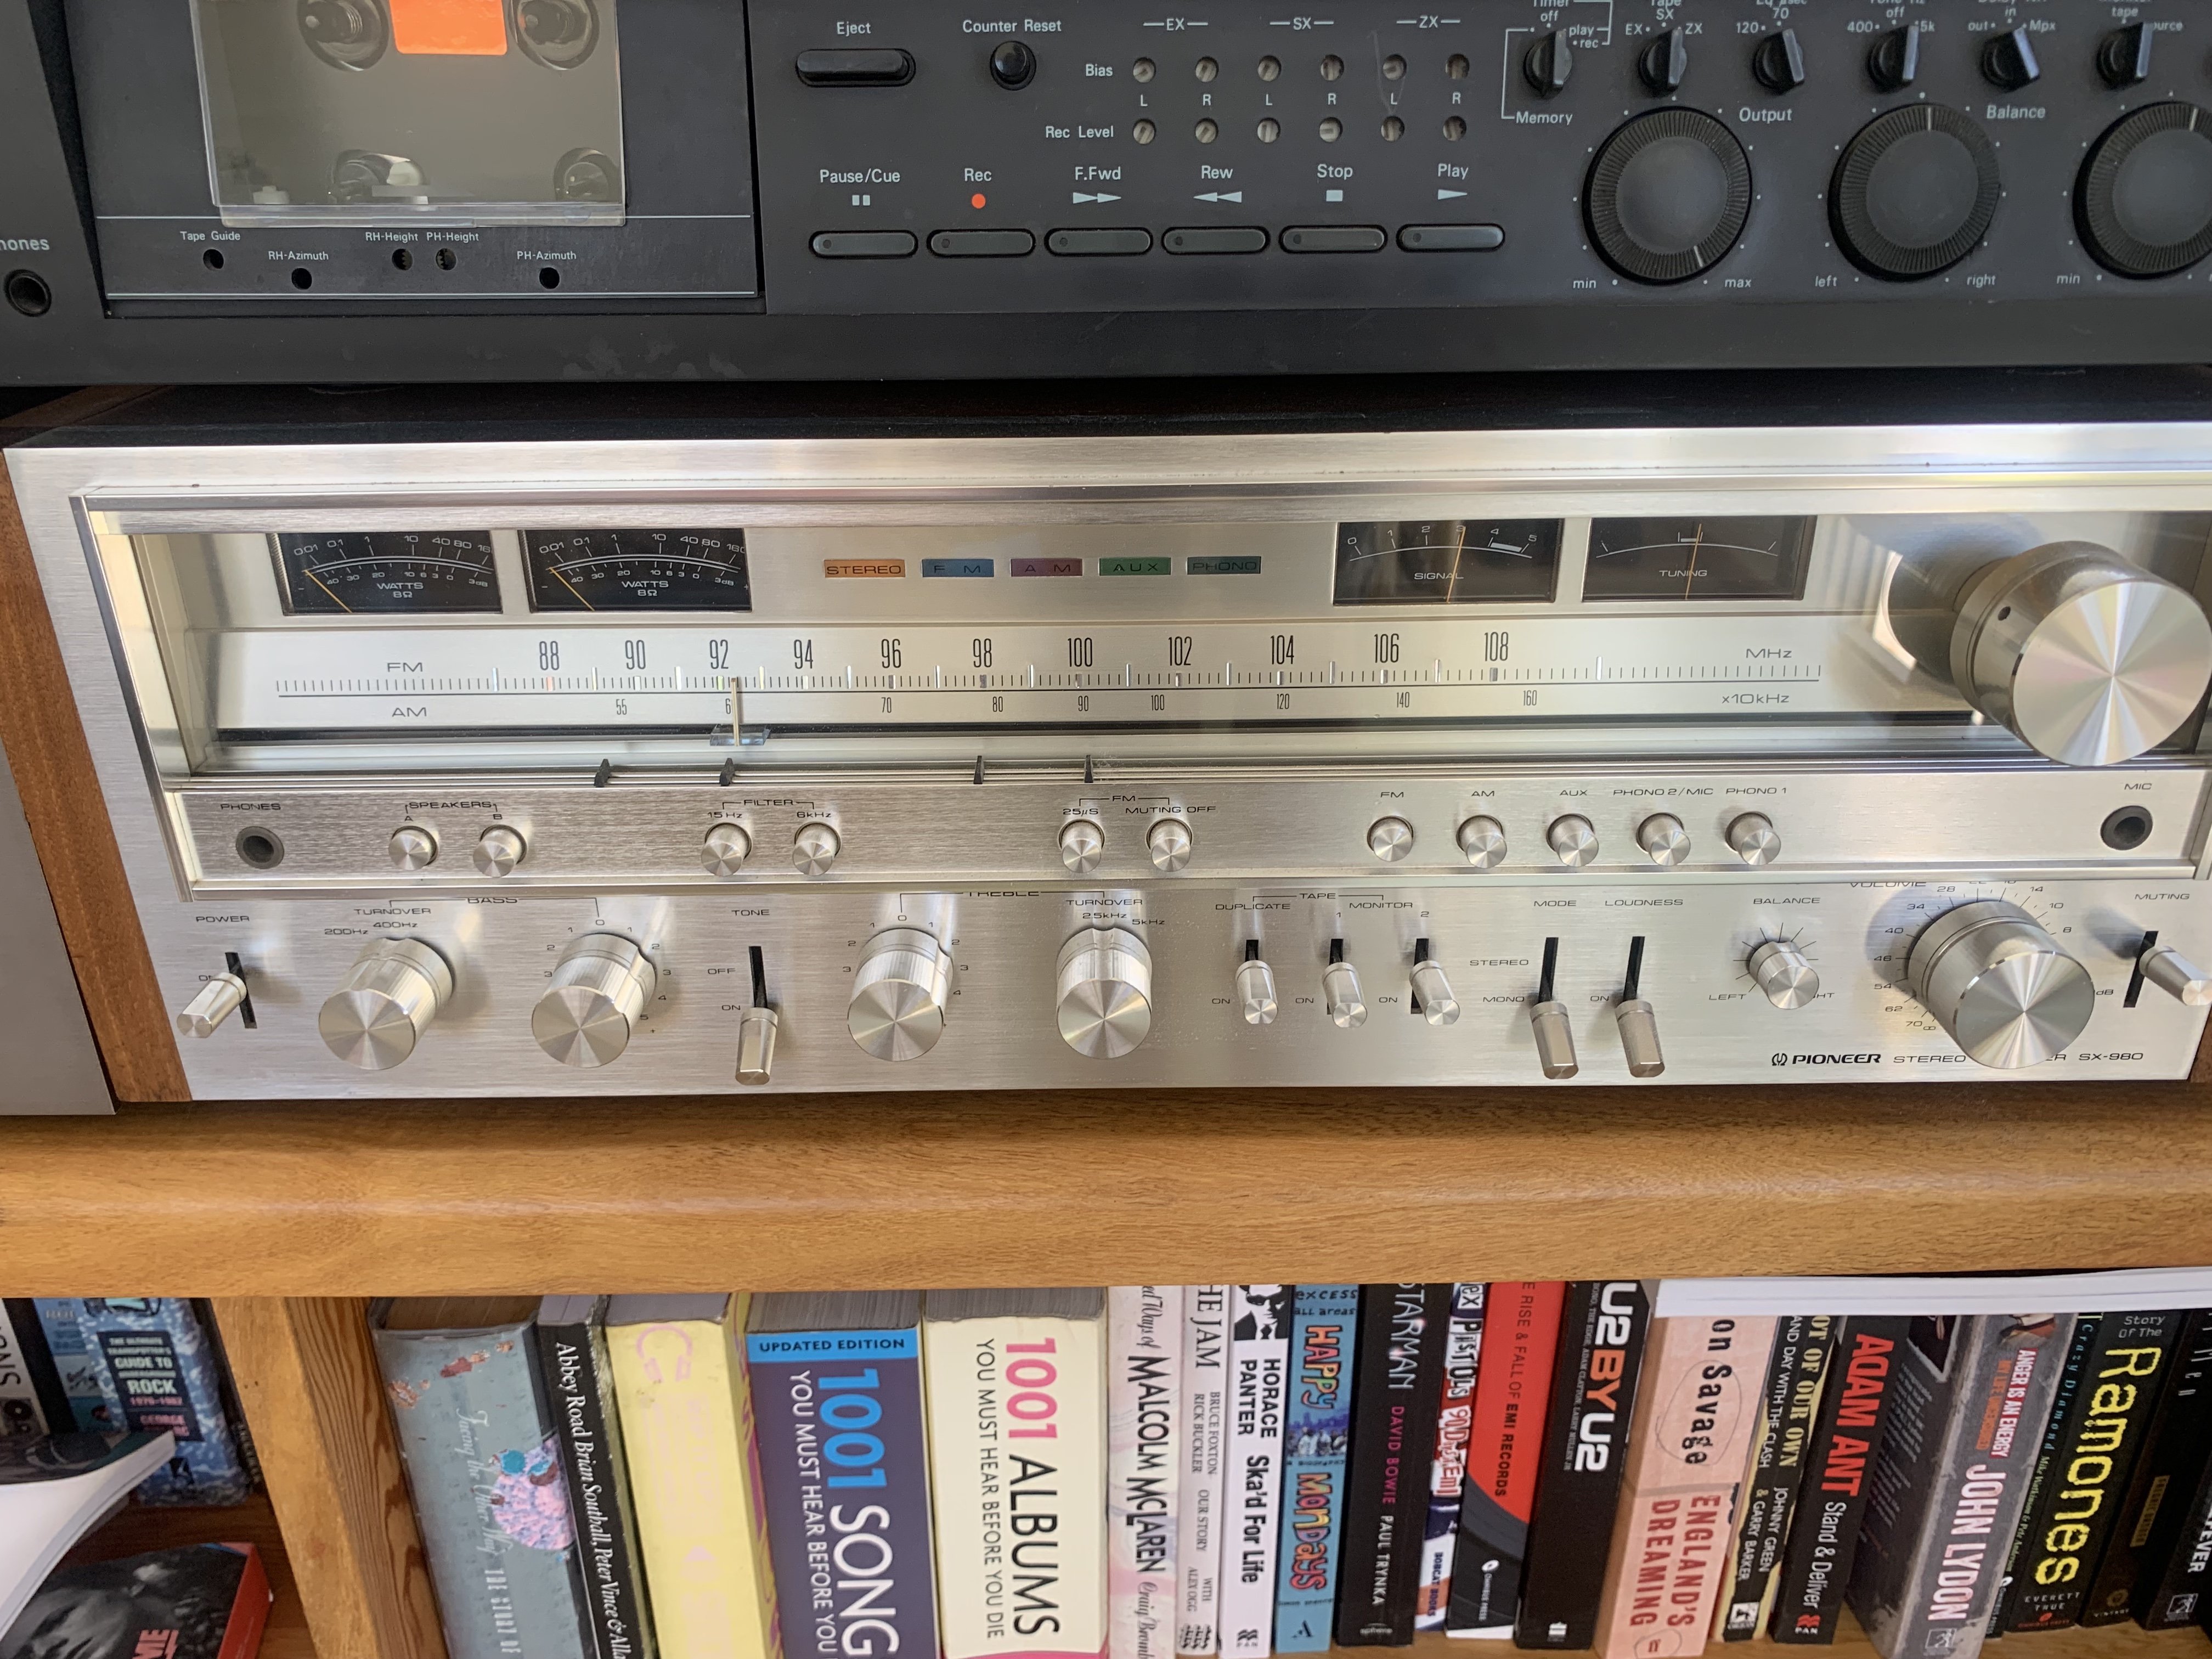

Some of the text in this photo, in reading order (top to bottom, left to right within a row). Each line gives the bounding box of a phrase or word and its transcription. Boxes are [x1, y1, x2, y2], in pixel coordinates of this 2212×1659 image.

[1773, 8, 1788, 19] 70
[837, 21, 871, 36] Eject
[962, 20, 1062, 32] Counter Reset
[1166, 18, 1185, 31] EX
[1293, 17, 1312, 30] SX
[1419, 16, 1438, 28] ZX
[1736, 22, 1759, 33] 120
[1847, 21, 1873, 32] 400
[1968, 21, 1988, 31] out
[2030, 20, 2056, 33] Mpx
[1569, 24, 1594, 36] play
[1085, 64, 1113, 77] Bias
[1140, 95, 1148, 106] L
[1203, 94, 1211, 106] R
[1516, 111, 1573, 125] Memory
[1739, 108, 1792, 123] Output
[1987, 105, 2045, 119] Balance
[1046, 126, 1114, 138] Rec Level
[820, 169, 900, 183] Pause/Cue
[964, 168, 992, 182] Rec
[1075, 167, 1121, 180] F.Fwd
[1201, 166, 1233, 179] Rew
[1317, 164, 1353, 182] Stop
[1437, 164, 1469, 179] Play
[180, 231, 241, 242] Tape Guide
[365, 232, 418, 244] RH-Height
[426, 232, 479, 244] PH-Height
[268, 251, 329, 261] RH-Azimuth
[517, 251, 577, 261] PH-Azimuth
[1573, 278, 1596, 289] min
[1725, 278, 1751, 288] max
[1815, 275, 1837, 287] left
[1967, 275, 1995, 287] right
[826, 566, 901, 575] STEREO
[1193, 562, 1257, 571] PHONO
[387, 631, 1792, 672] FM 88 90 92 94 96 98 100 102 104 106 108 MHz
[392, 690, 1789, 716] AM 70 80 90 100 120 140 160 x10kHz
[1792, 1054, 1881, 1064] PIONEER
[760, 1339, 904, 1352] UPDATED EDITION
[1190, 1317, 1221, 1368] JAM
[115, 1357, 172, 1368] GUIDE TO
[127, 1379, 177, 1394] ROCK
[1238, 1359, 1258, 1435] PANTER
[1260, 1358, 1281, 1438] HORACE
[1495, 1295, 1533, 1497] RISE & FALL OF EMI RECORDS
[1127, 1356, 1172, 1471] MALCOLM
[1682, 1364, 1732, 1465] Savage
[819, 1368, 887, 1488] 1001
[1207, 1392, 1221, 1475] BRUCE FOXTON
[1387, 1406, 1405, 1452] DAVID
[1803, 1334, 1895, 1609] ADAM ANT Stand Deliver
[2035, 1347, 2162, 1585] Ramones
[556, 1342, 620, 1618] Abbey Road Brian Southall, Peter Vince
[1005, 1336, 1060, 1635] 1001 ALBUMS
[1383, 1458, 1400, 1505] BOWIE
[789, 1370, 833, 1609] YOU MUST HEAR BEFORE
[977, 1338, 1004, 1638] YOU MUST HEAR BEFORE YOU DIE
[1951, 1464, 2007, 1535] JOHN
[1244, 1515, 1266, 1544] For
[1378, 1515, 1395, 1550] PAUL
[1242, 1550, 1264, 1583] Life
[1629, 1499, 1681, 1627] DREAMING
[1667, 1495, 1721, 1627] ENGLAND'S
[1372, 1554, 1391, 1606] TRYNKA
[1927, 1543, 1987, 1621] LYDON
